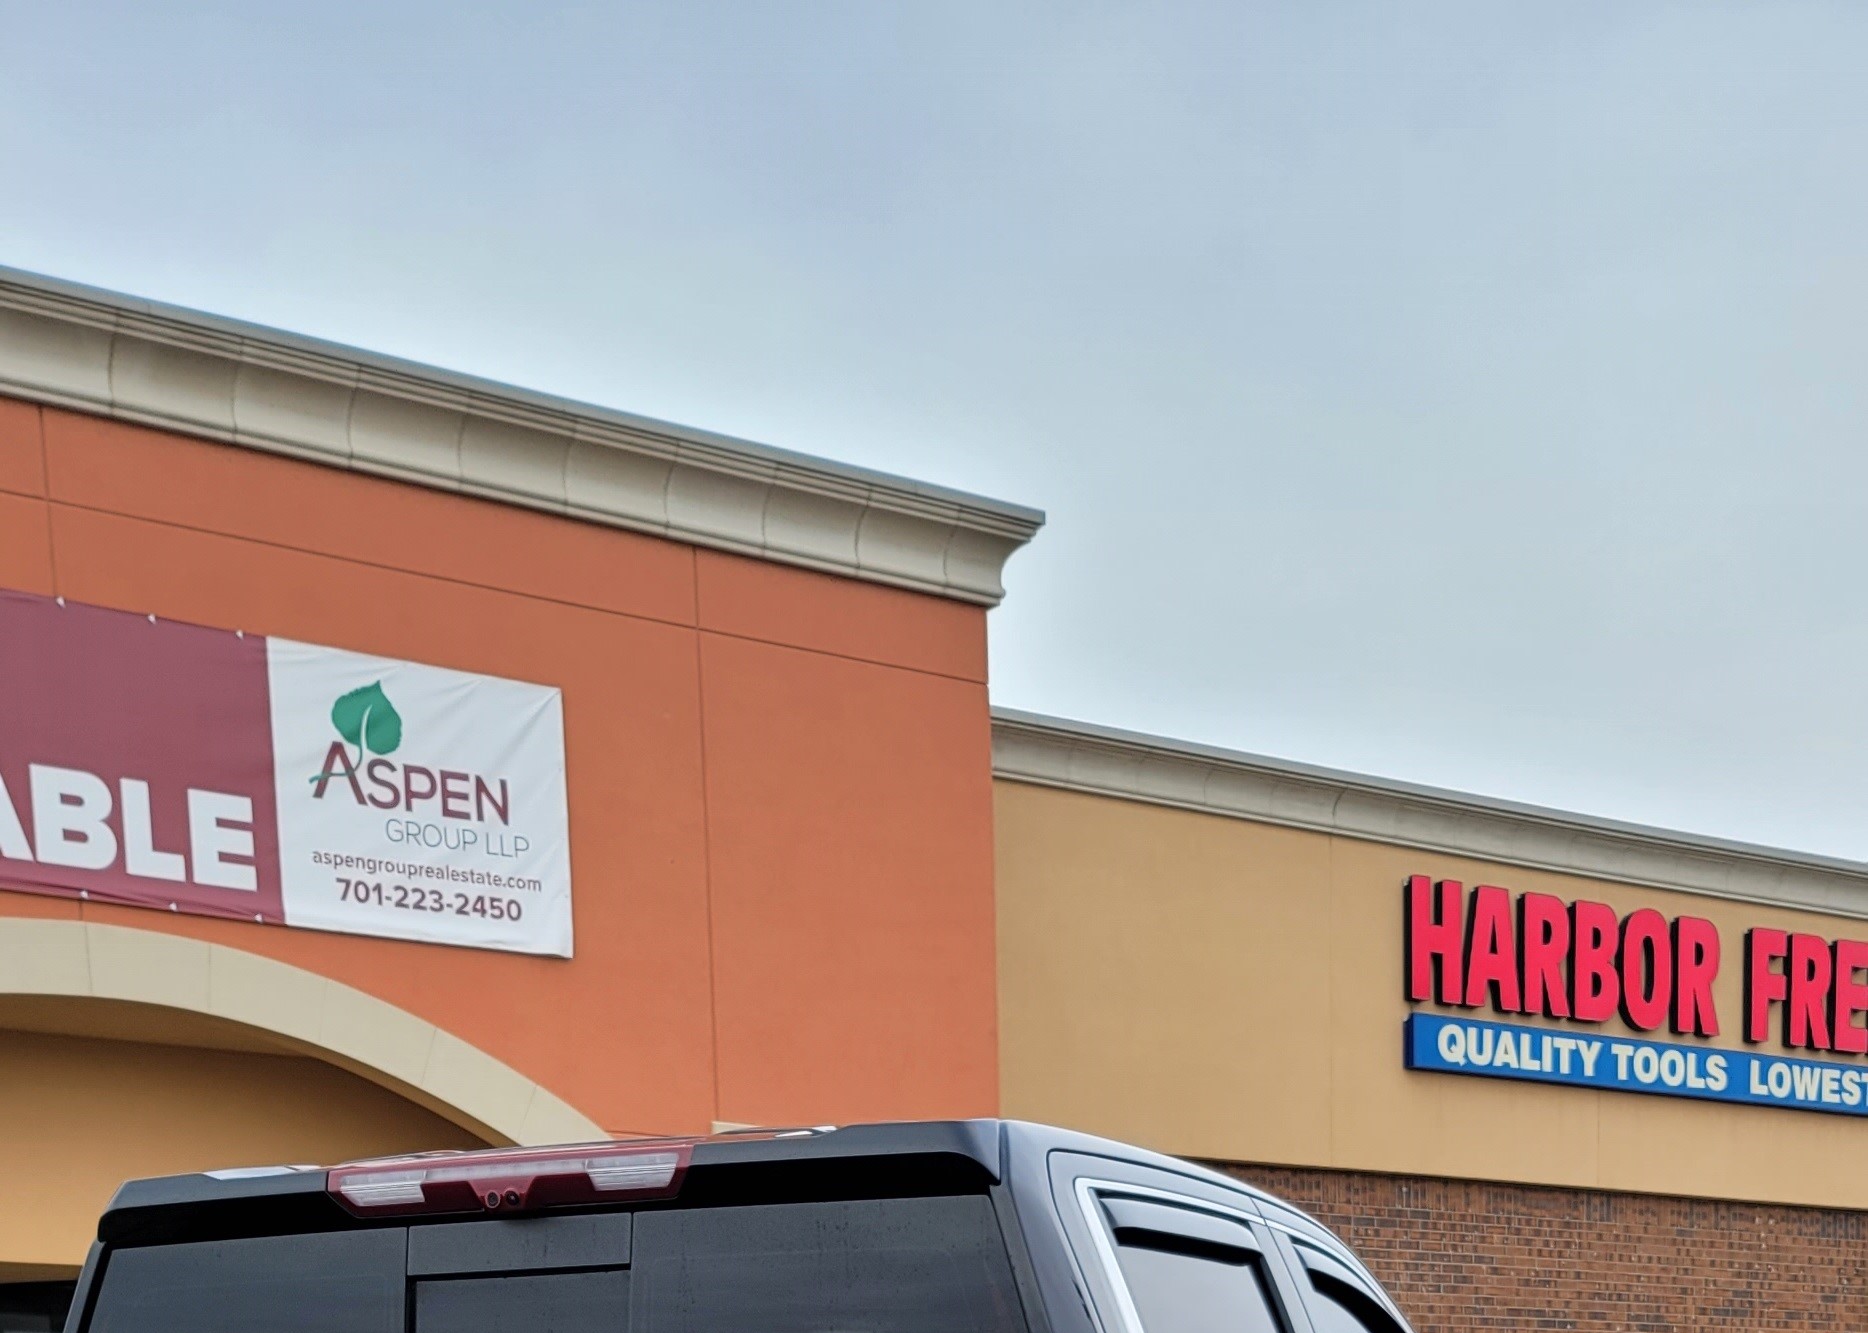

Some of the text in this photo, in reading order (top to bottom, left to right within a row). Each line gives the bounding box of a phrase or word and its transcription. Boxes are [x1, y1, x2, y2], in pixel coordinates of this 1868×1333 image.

[311, 741, 509, 826] ASPEN
[386, 818, 530, 858] GROUP LLP
[312, 851, 542, 892] aspengrouprealestate.com
[336, 877, 523, 921] 701-223-2450
[1406, 874, 1720, 1037] HARBOR
[1437, 1023, 1602, 1077] QUALITY
[1611, 1043, 1728, 1092] TOOLS
